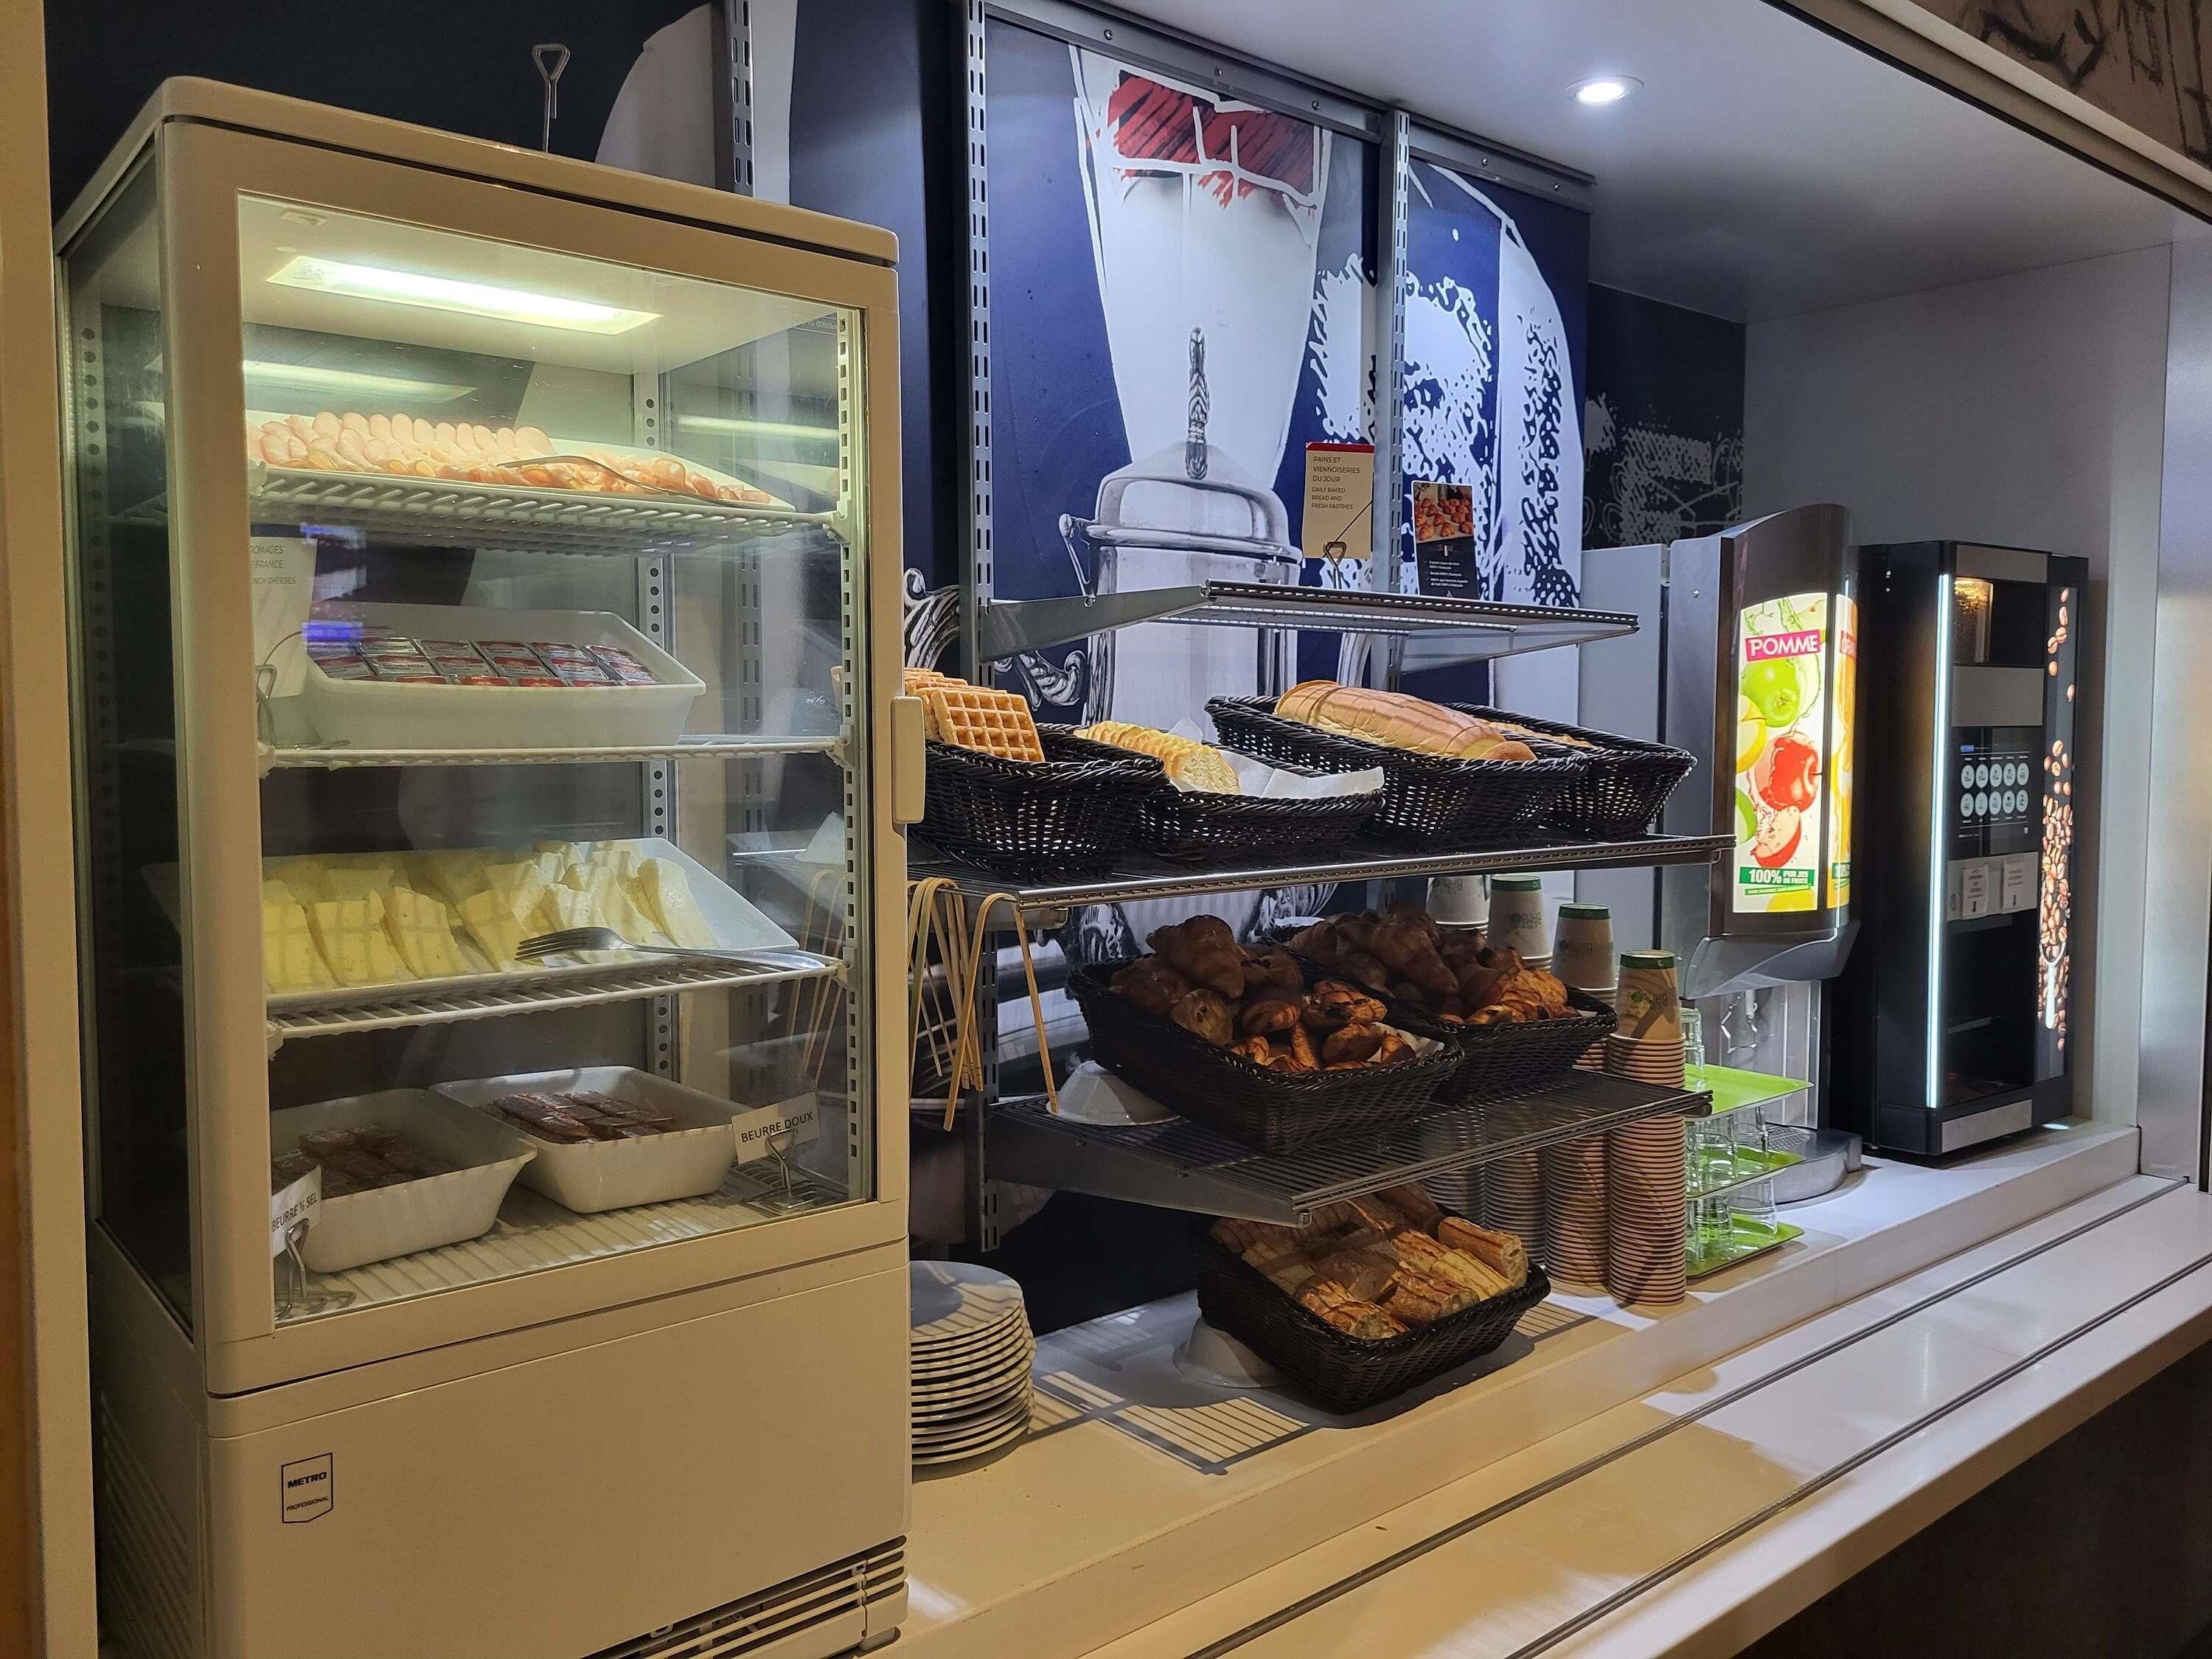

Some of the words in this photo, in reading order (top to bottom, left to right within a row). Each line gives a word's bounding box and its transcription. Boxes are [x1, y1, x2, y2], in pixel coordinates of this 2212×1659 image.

[1312, 465, 1361, 474] VIENNOISERIES
[1323, 475, 1340, 483] JOUR
[255, 560, 284, 569] FRANCE
[267, 576, 296, 585] CHEESES
[1748, 634, 1819, 657] POMME
[1748, 869, 1782, 884] 100%
[741, 1121, 782, 1143] BEURRE
[784, 1110, 814, 1130] DOUX
[272, 1204, 299, 1232] BEURRE
[305, 1191, 318, 1208] SEL
[288, 1471, 327, 1489] METRO
[286, 1495, 330, 1512] PROFESSIONAL
